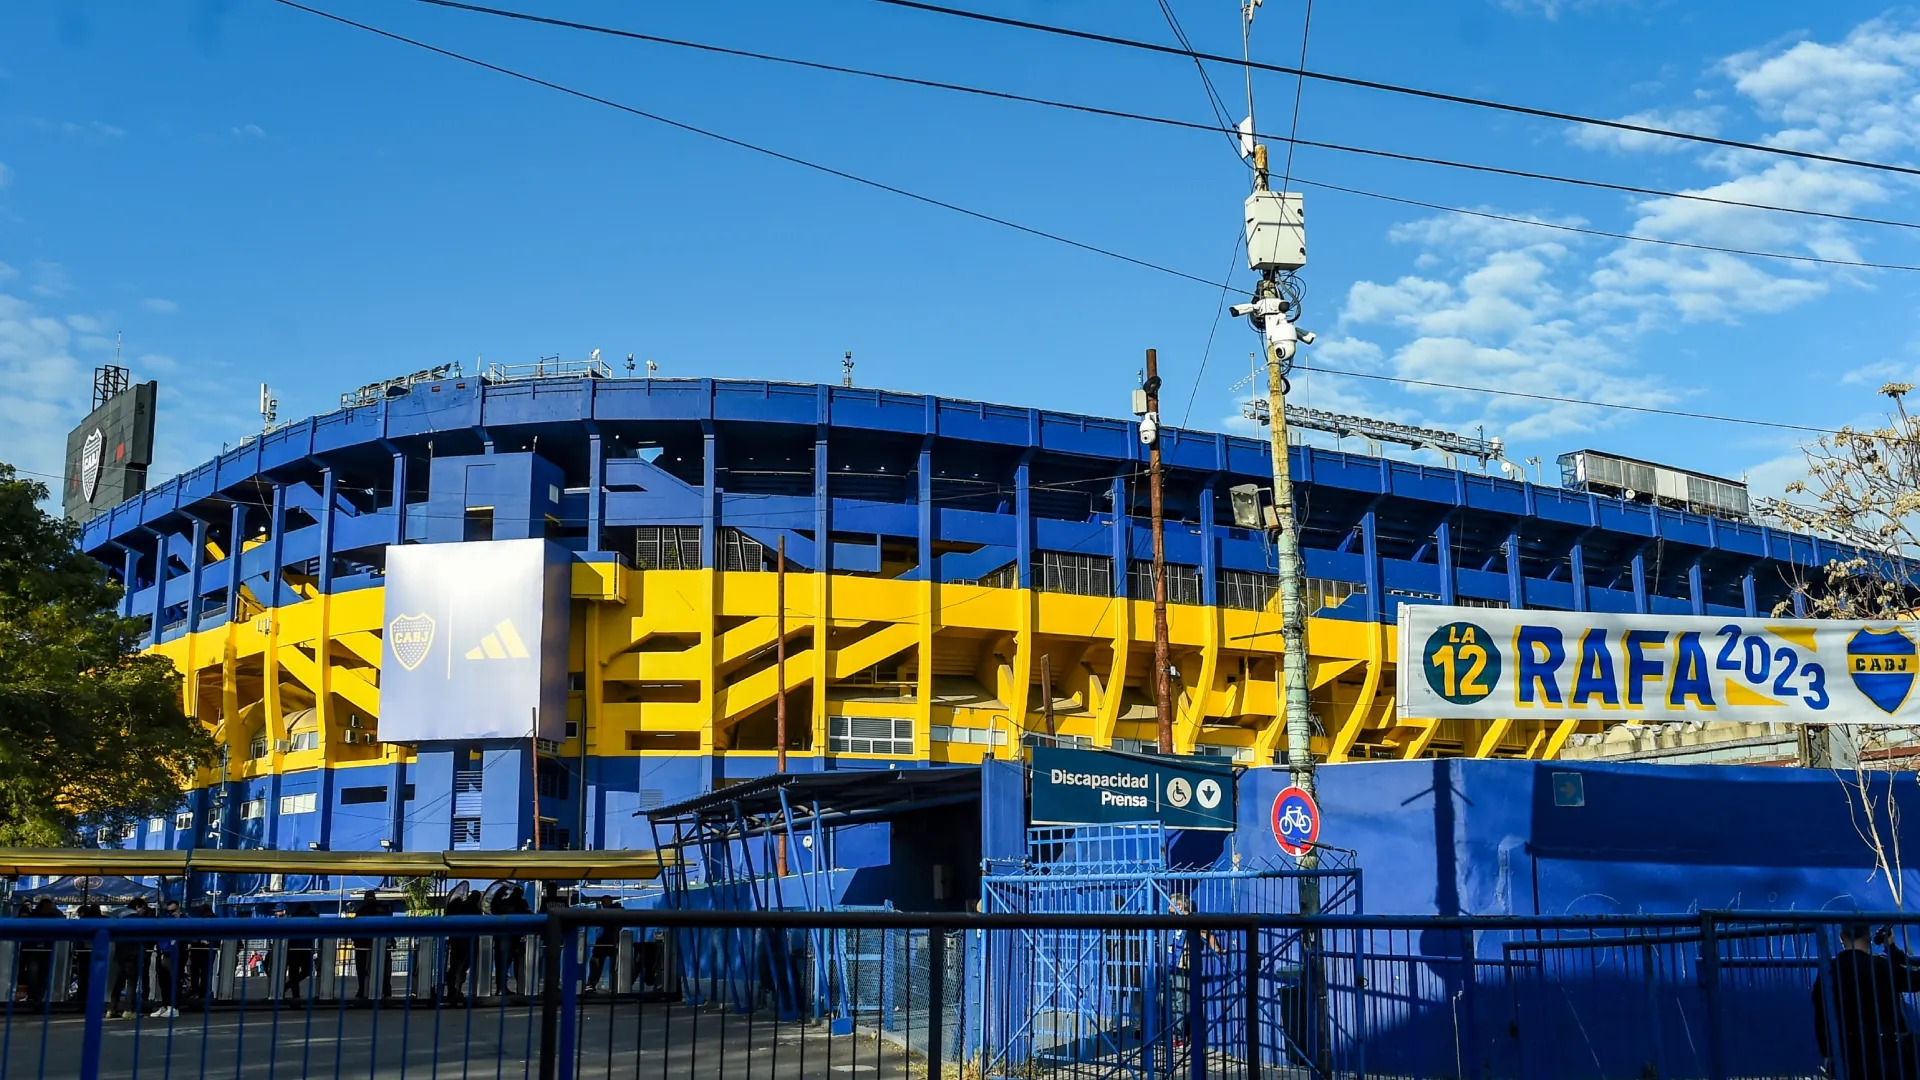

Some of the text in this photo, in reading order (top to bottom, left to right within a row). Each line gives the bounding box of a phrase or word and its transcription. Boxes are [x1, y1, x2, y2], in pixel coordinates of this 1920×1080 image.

[395, 631, 429, 644] CABJ
[1448, 626, 1476, 644] LA
[1431, 644, 1489, 697] 12
[1511, 624, 1830, 711] RAFA 2023
[1855, 657, 1908, 672] CABJ
[1050, 768, 1149, 790] Discapacidad
[1101, 790, 1148, 807] Prensa
